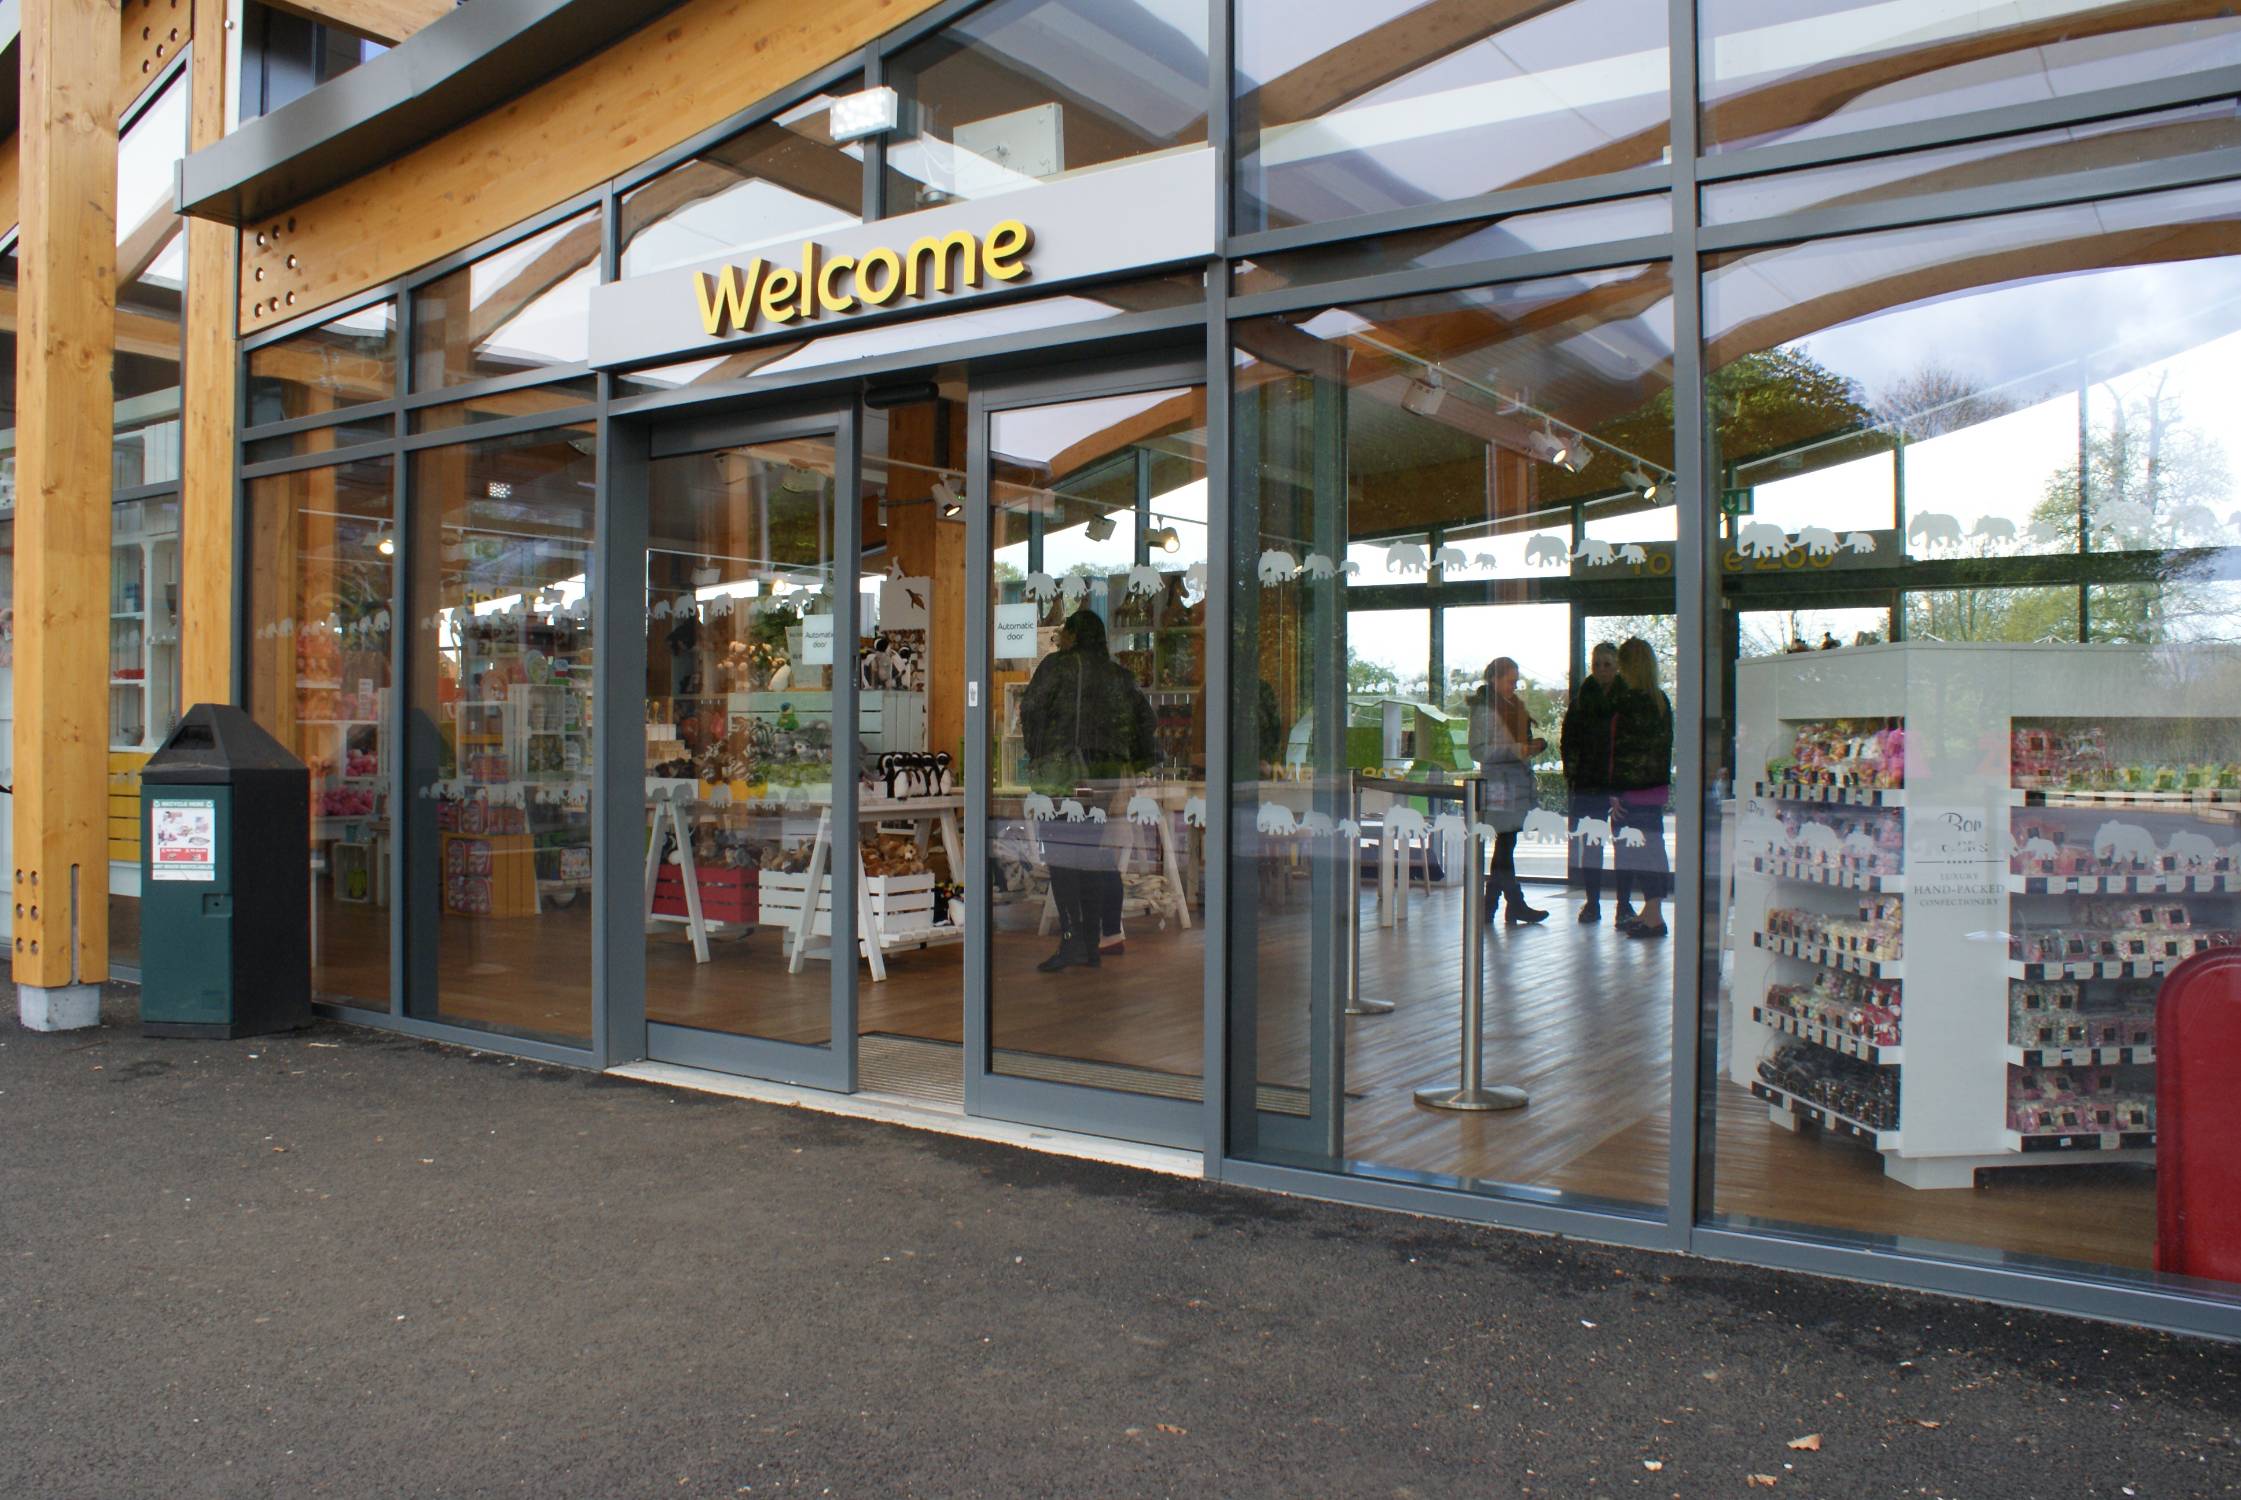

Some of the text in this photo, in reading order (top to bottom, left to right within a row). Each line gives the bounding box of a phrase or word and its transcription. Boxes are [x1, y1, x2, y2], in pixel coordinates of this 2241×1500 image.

[693, 218, 1033, 336] Welcome
[997, 622, 1035, 631] Automatic
[804, 631, 834, 639] Automati
[1006, 632, 1025, 641] door
[1940, 872, 1979, 880] LUXURY
[1914, 884, 2006, 896] HAND-PACKED
